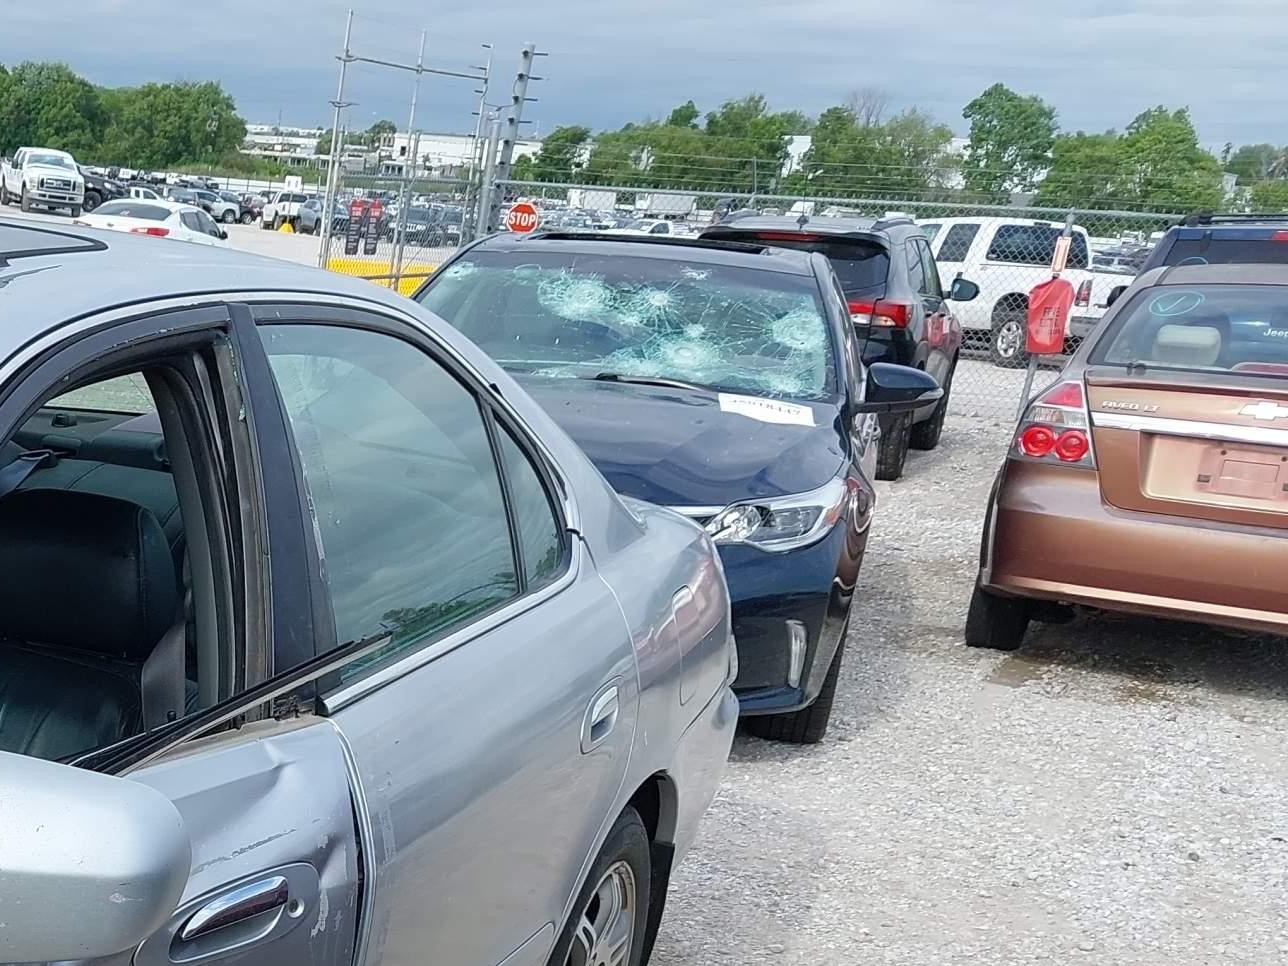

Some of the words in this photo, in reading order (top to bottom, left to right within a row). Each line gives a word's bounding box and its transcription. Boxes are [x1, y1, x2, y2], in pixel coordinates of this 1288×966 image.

[509, 211, 536, 227] STOP
[1102, 400, 1139, 411] AVEO
[1144, 404, 1160, 412] LT
